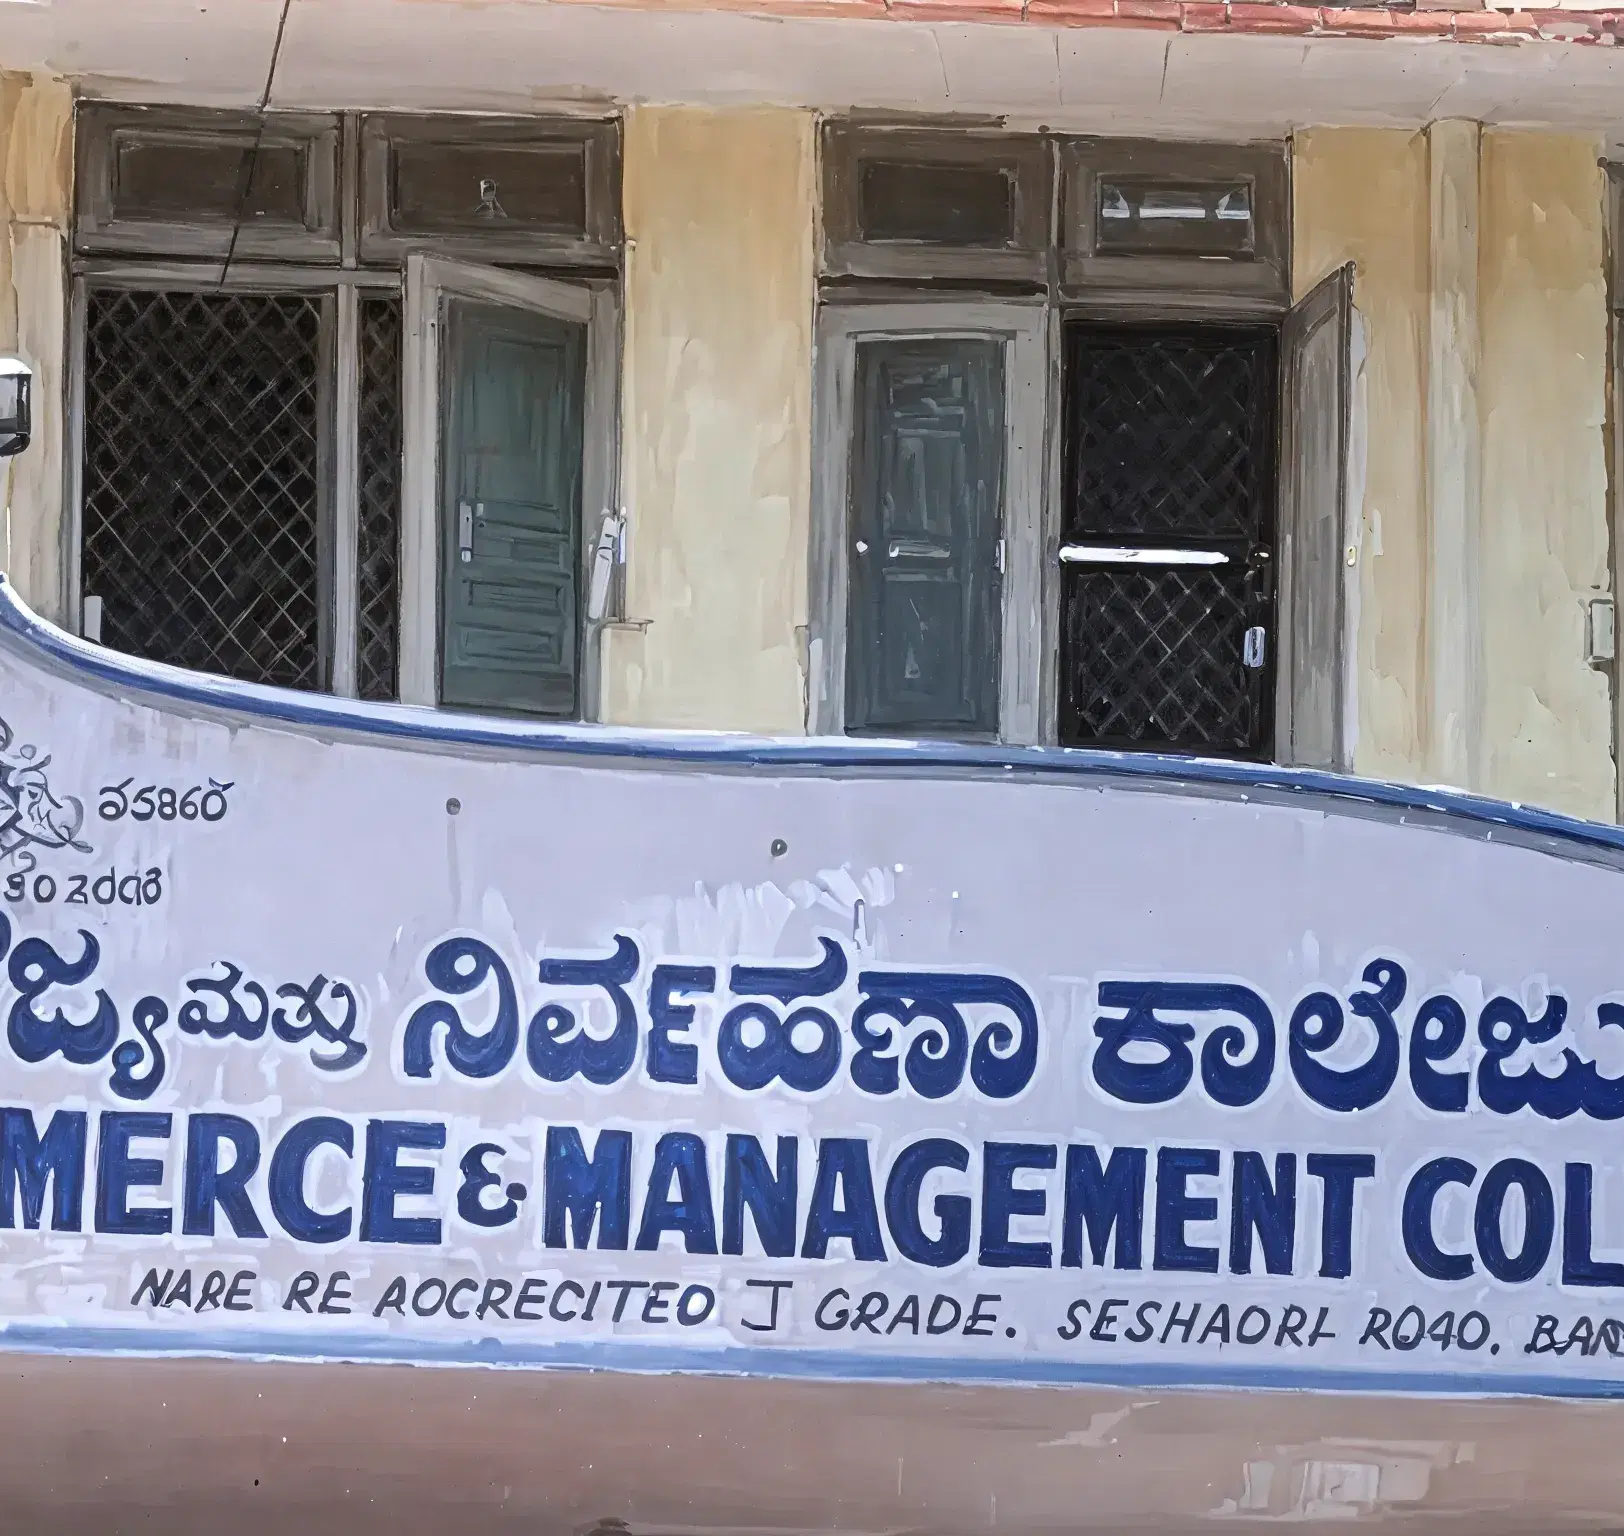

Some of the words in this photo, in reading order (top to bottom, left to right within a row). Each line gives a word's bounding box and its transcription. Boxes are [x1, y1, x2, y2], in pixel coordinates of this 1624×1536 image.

[178, 961, 367, 1071] ಮತ್ತು
[403, 934, 1038, 1099] ನಿರ್ವಹಣಾ
[457, 1143, 527, 1227] &
[544, 1126, 1375, 1278] MANAGEMENT
